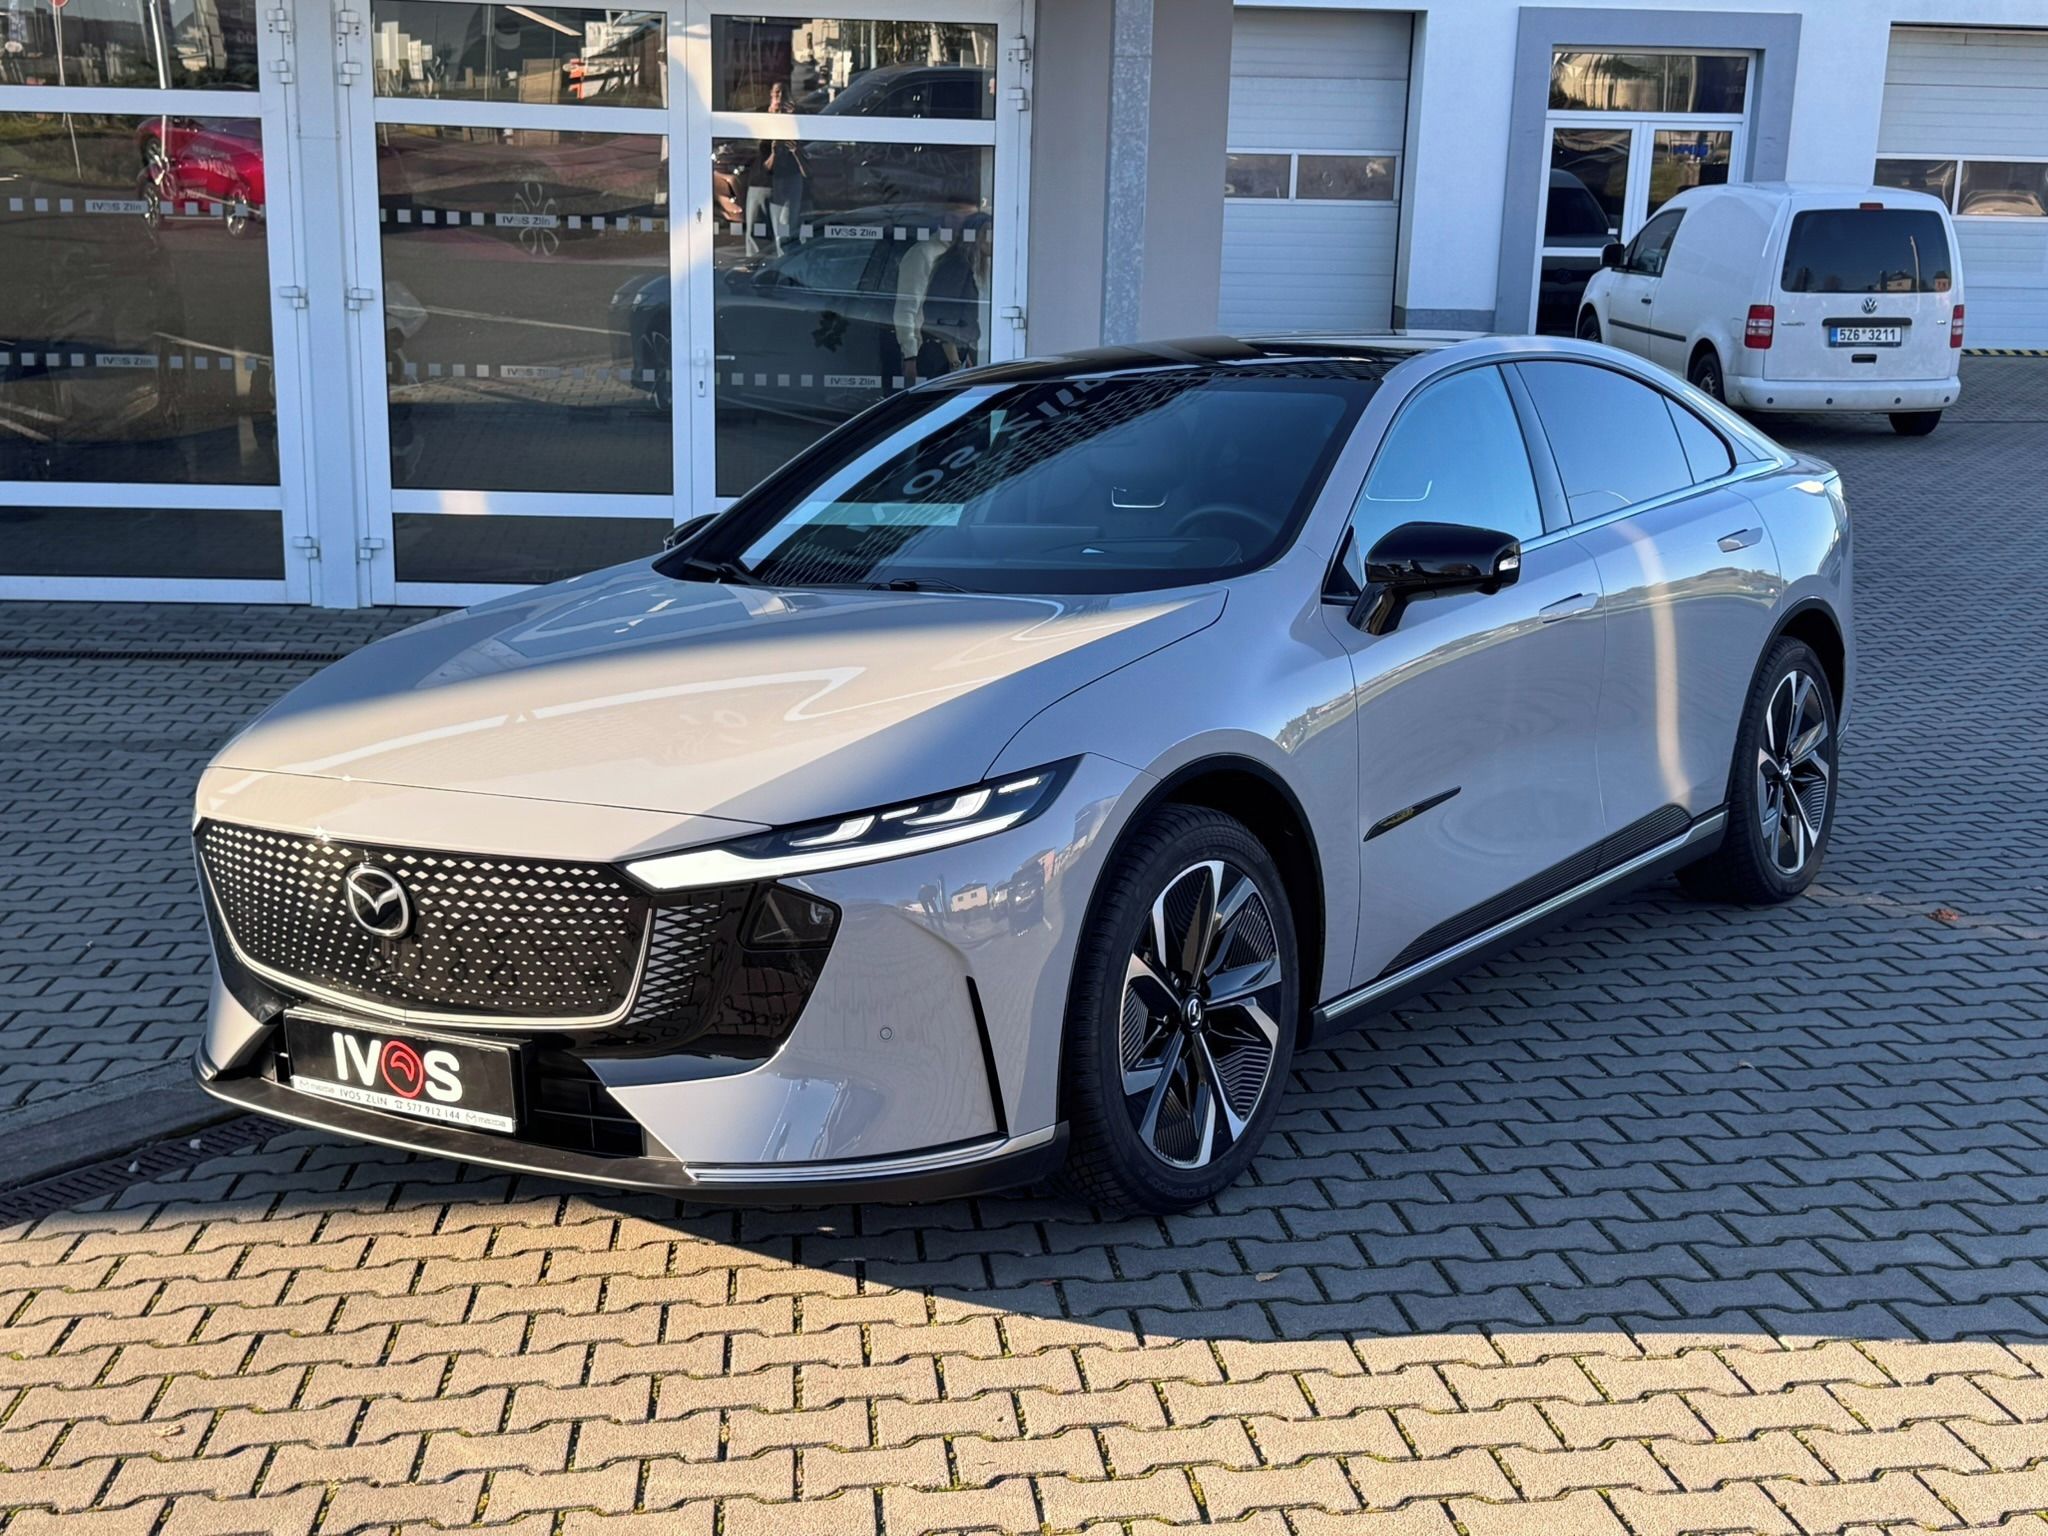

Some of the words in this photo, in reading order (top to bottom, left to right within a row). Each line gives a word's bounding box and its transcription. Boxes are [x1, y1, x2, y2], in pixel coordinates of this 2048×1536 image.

[1839, 328, 1860, 341] 5Z6
[1868, 328, 1895, 341] 3211
[332, 1031, 463, 1102] IVOS
[339, 1088, 361, 1101] IVOS
[406, 1102, 422, 1113] 577
[425, 1105, 441, 1117] 912
[445, 1109, 460, 1120] 144
